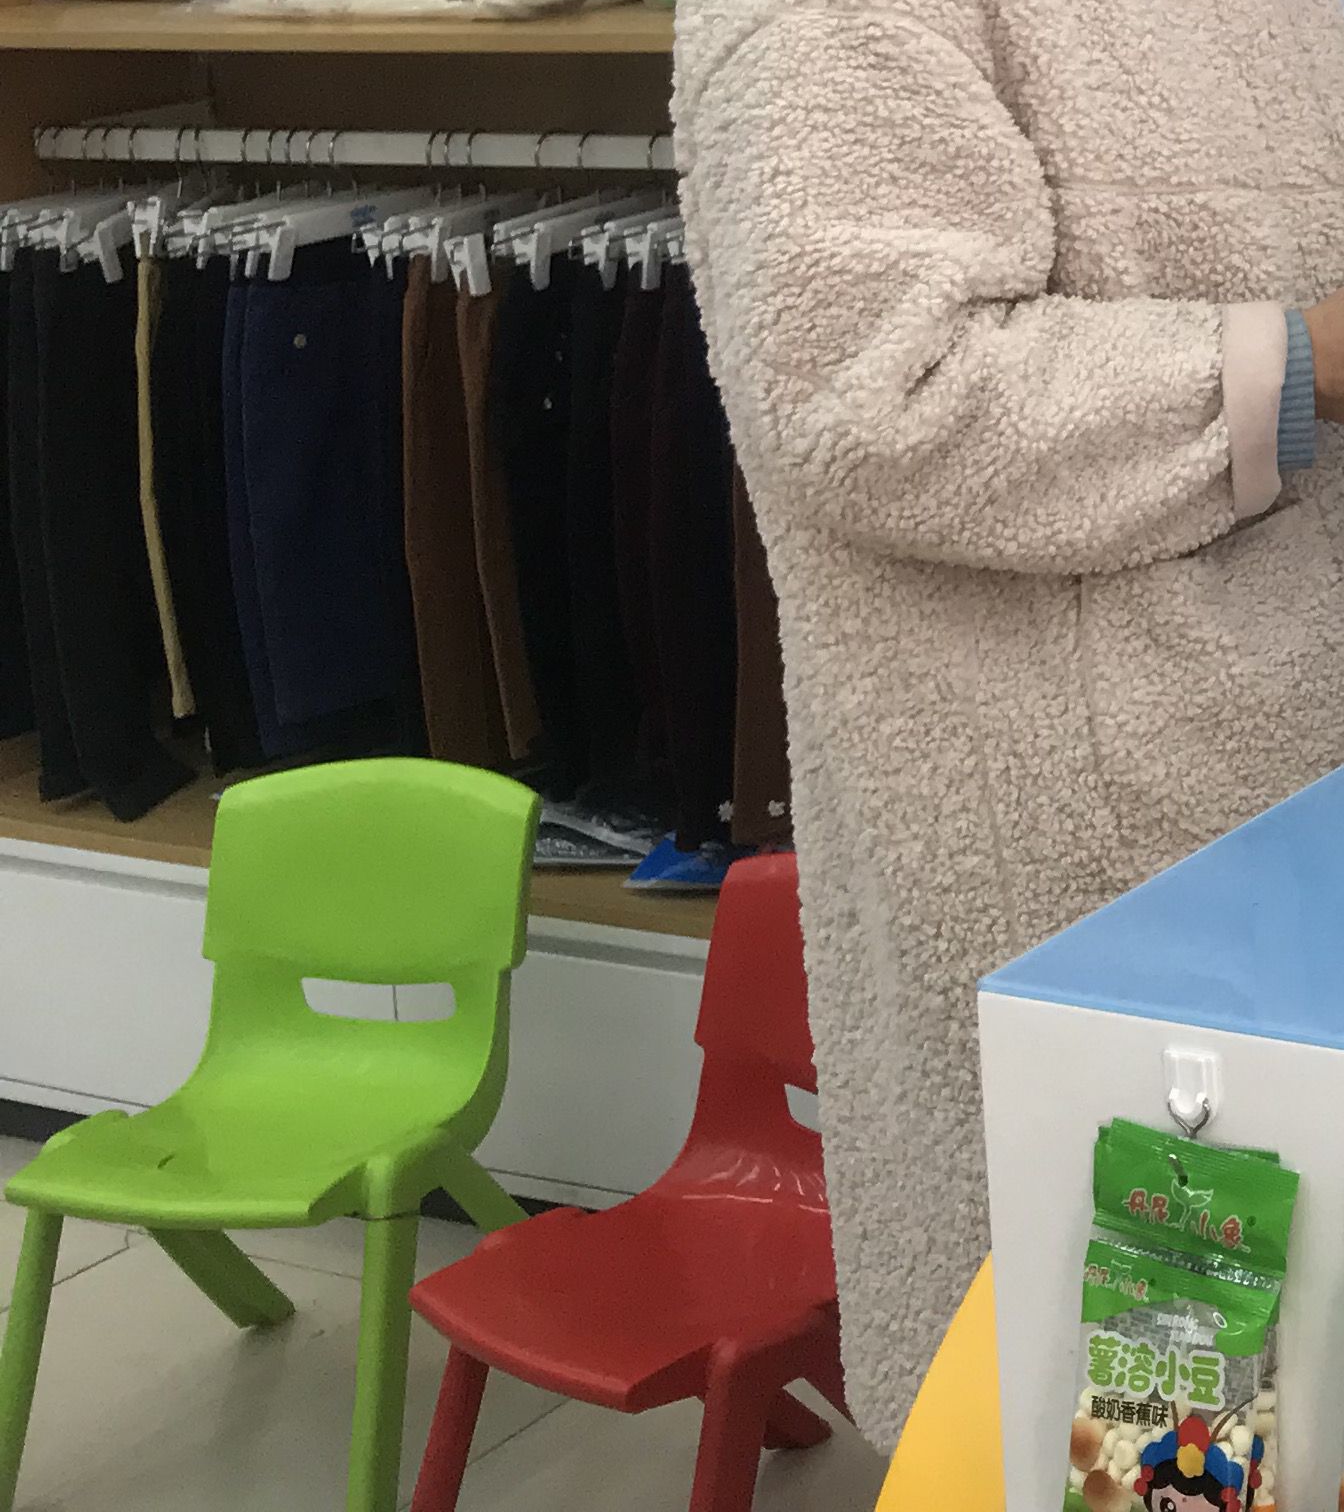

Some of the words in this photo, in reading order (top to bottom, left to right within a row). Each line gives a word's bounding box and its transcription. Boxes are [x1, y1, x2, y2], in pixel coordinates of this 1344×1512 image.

[1085, 1333, 1226, 1410] 薯溶小豆
[1090, 1398, 1169, 1429] 酸奶香蕉味
